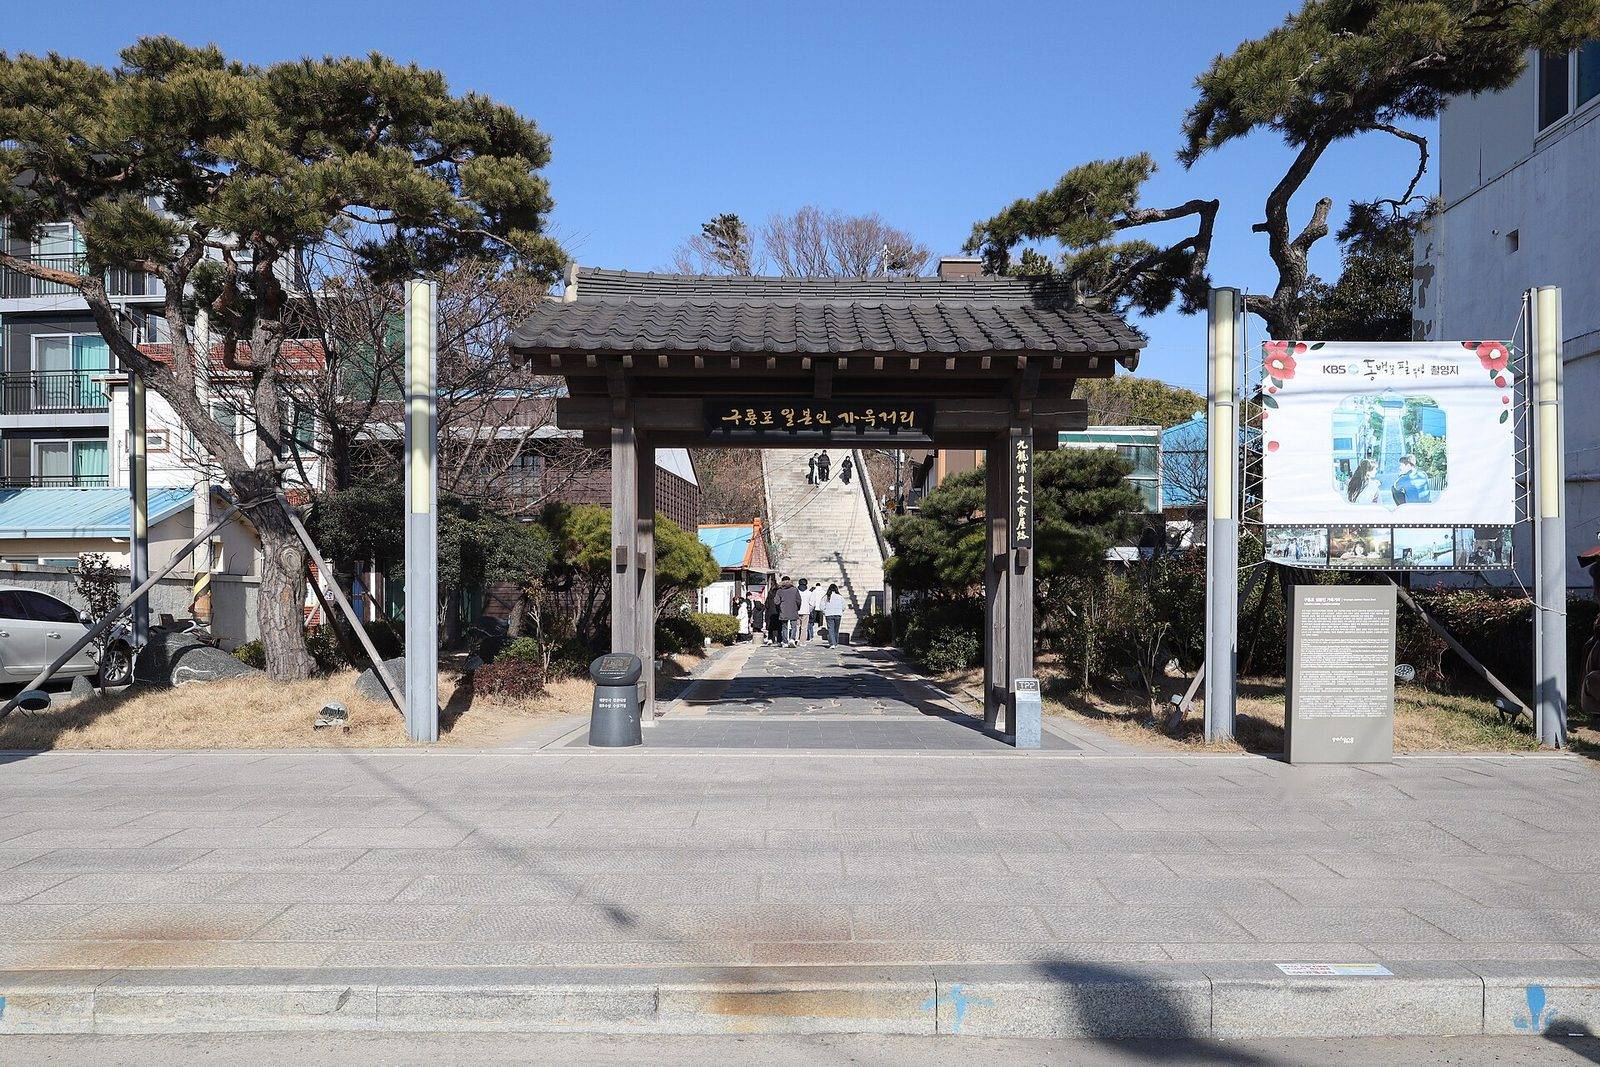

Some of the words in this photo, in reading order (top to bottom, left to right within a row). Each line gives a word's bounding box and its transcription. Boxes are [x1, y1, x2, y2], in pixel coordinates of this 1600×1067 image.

[1322, 365, 1347, 375] KBS
[1430, 365, 1459, 376] 촬영지
[722, 408, 774, 426] 구룡포
[780, 408, 831, 427] 일본인
[838, 408, 915, 427] 가옥거리
